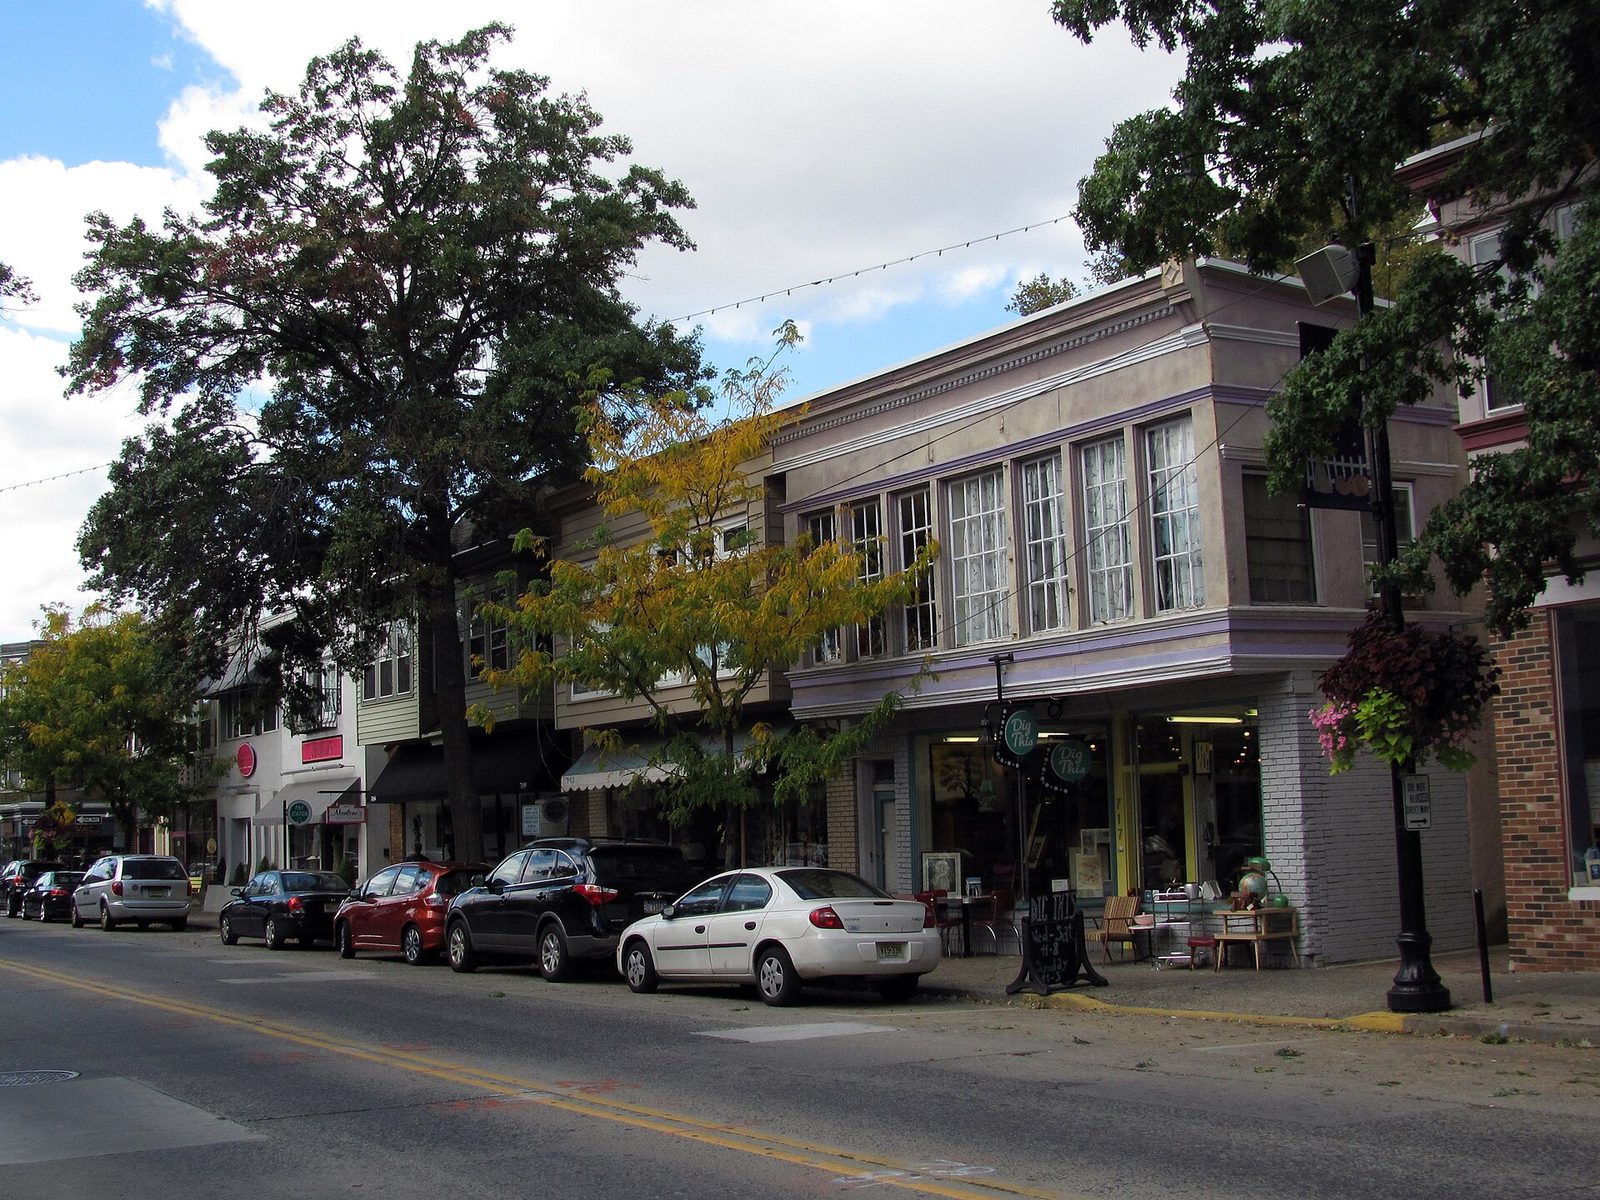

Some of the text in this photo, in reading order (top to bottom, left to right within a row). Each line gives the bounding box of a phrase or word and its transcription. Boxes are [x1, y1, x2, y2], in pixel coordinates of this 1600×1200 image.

[1011, 718, 1031, 737] Dig
[1011, 732, 1034, 748] This
[1058, 746, 1083, 764] Dig
[1058, 759, 1086, 775] This
[1052, 891, 1076, 921] THIS
